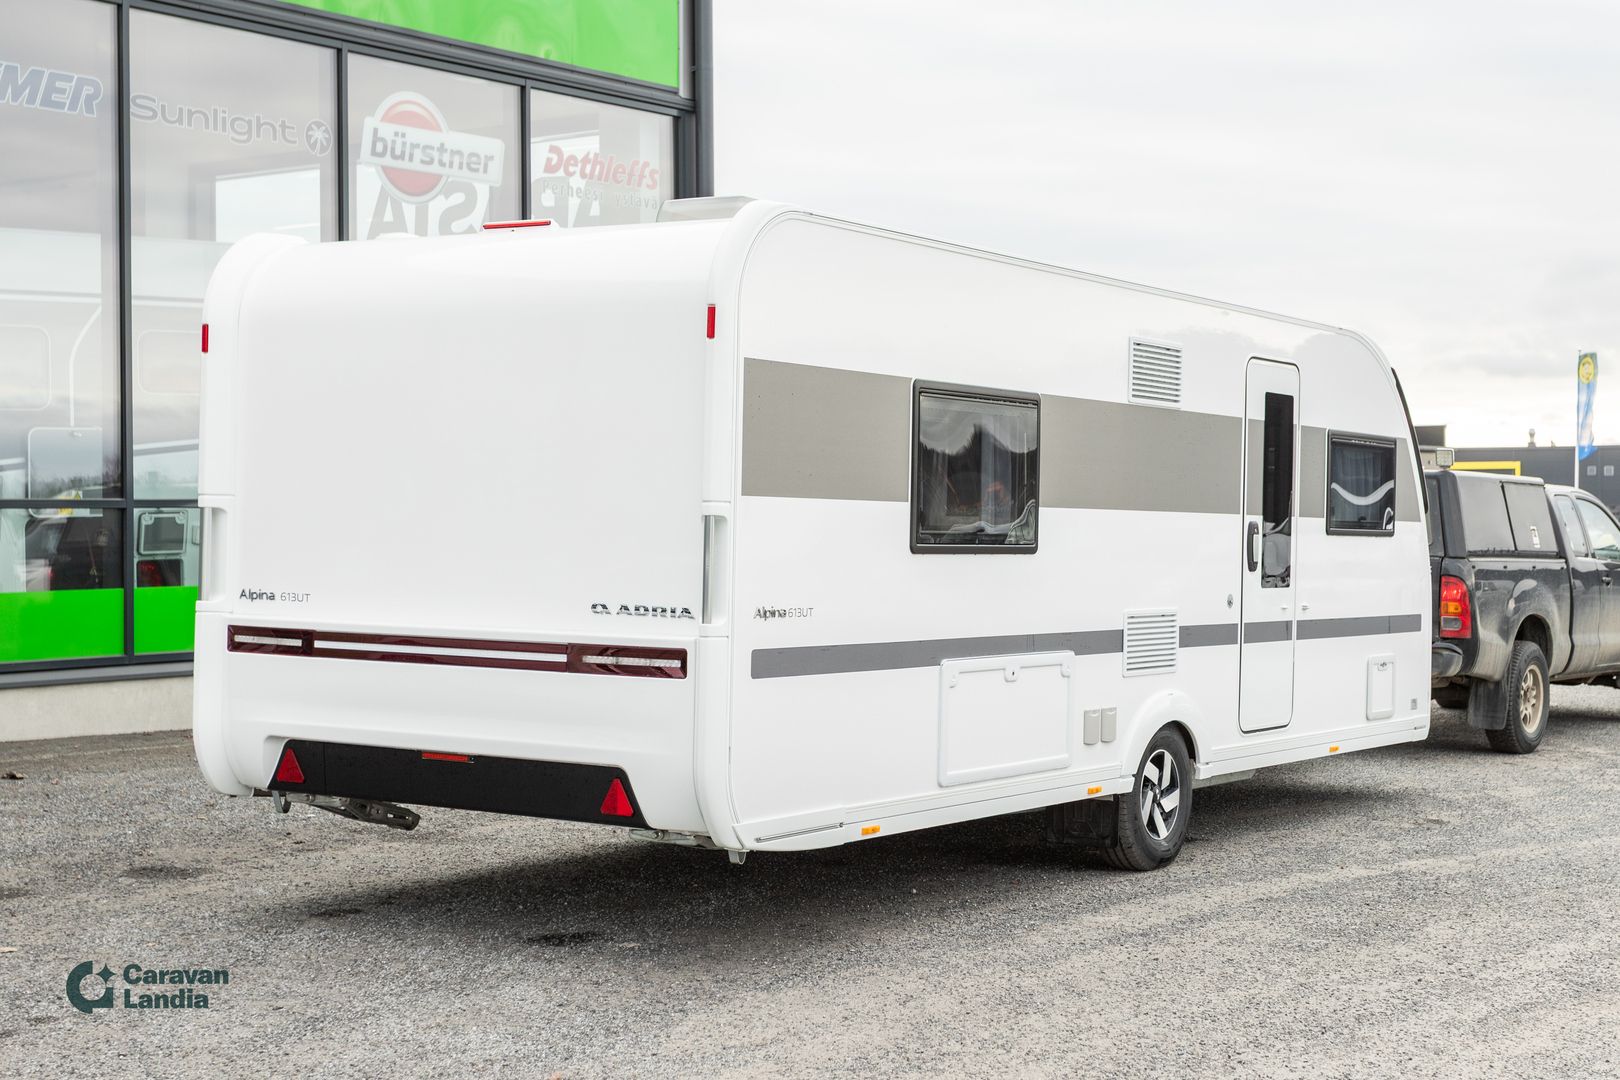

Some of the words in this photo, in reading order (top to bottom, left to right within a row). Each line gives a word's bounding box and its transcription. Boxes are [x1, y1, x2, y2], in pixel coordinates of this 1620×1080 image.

[0, 61, 103, 117] MER
[130, 94, 298, 145] Sunlight
[370, 127, 495, 174] bürstner
[543, 144, 660, 190] Dethleffs
[239, 588, 276, 602] Alpina
[280, 592, 312, 603] 613UT
[616, 604, 695, 619] ADRIA
[753, 605, 787, 621] Alpina
[787, 607, 814, 618] 613UT
